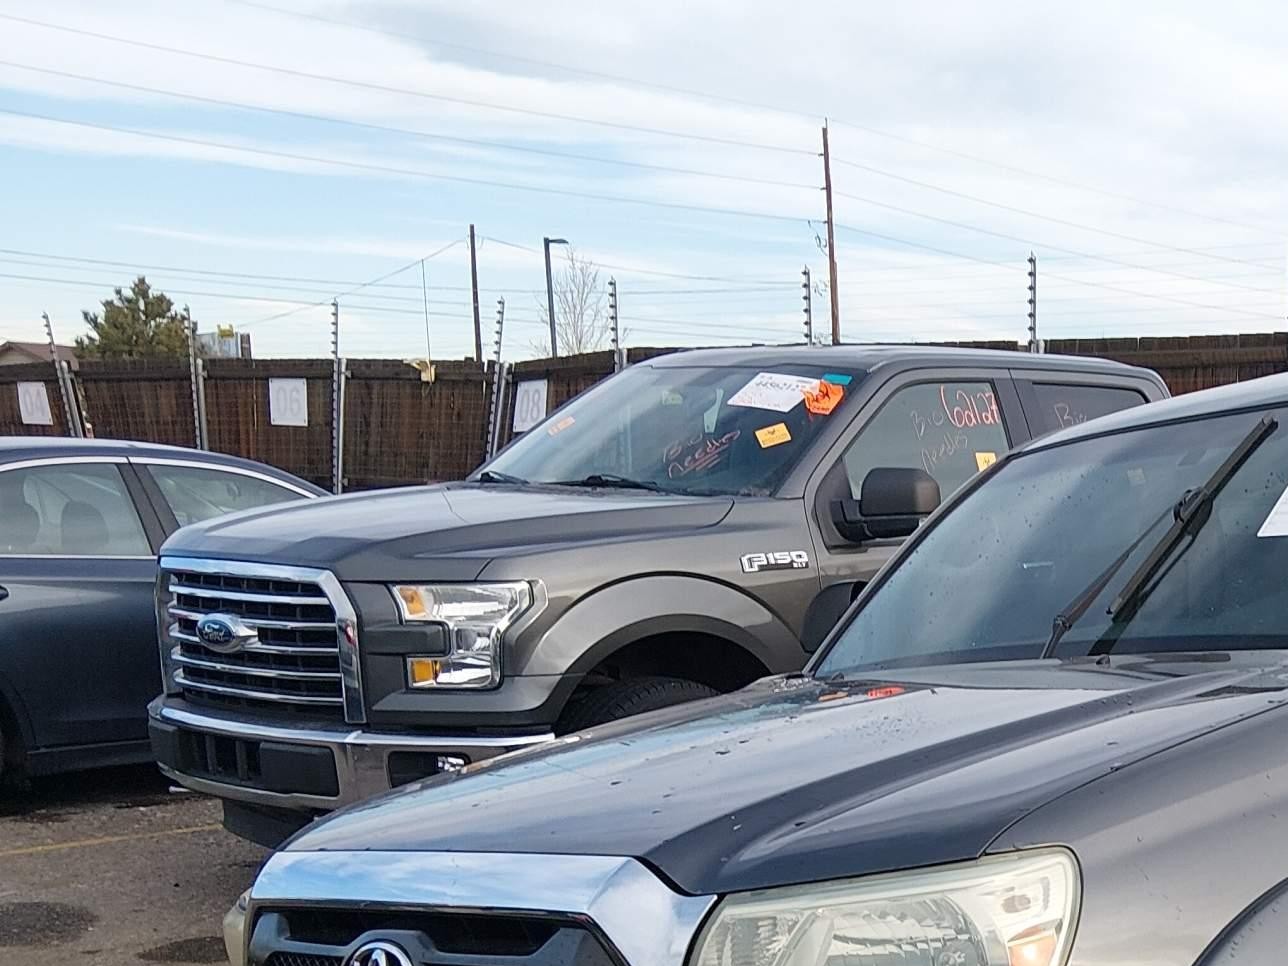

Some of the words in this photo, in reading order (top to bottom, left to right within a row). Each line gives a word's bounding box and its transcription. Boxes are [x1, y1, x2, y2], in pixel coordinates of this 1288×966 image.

[276, 386, 301, 417] 06
[520, 388, 541, 424] 08
[741, 550, 809, 573] F150
